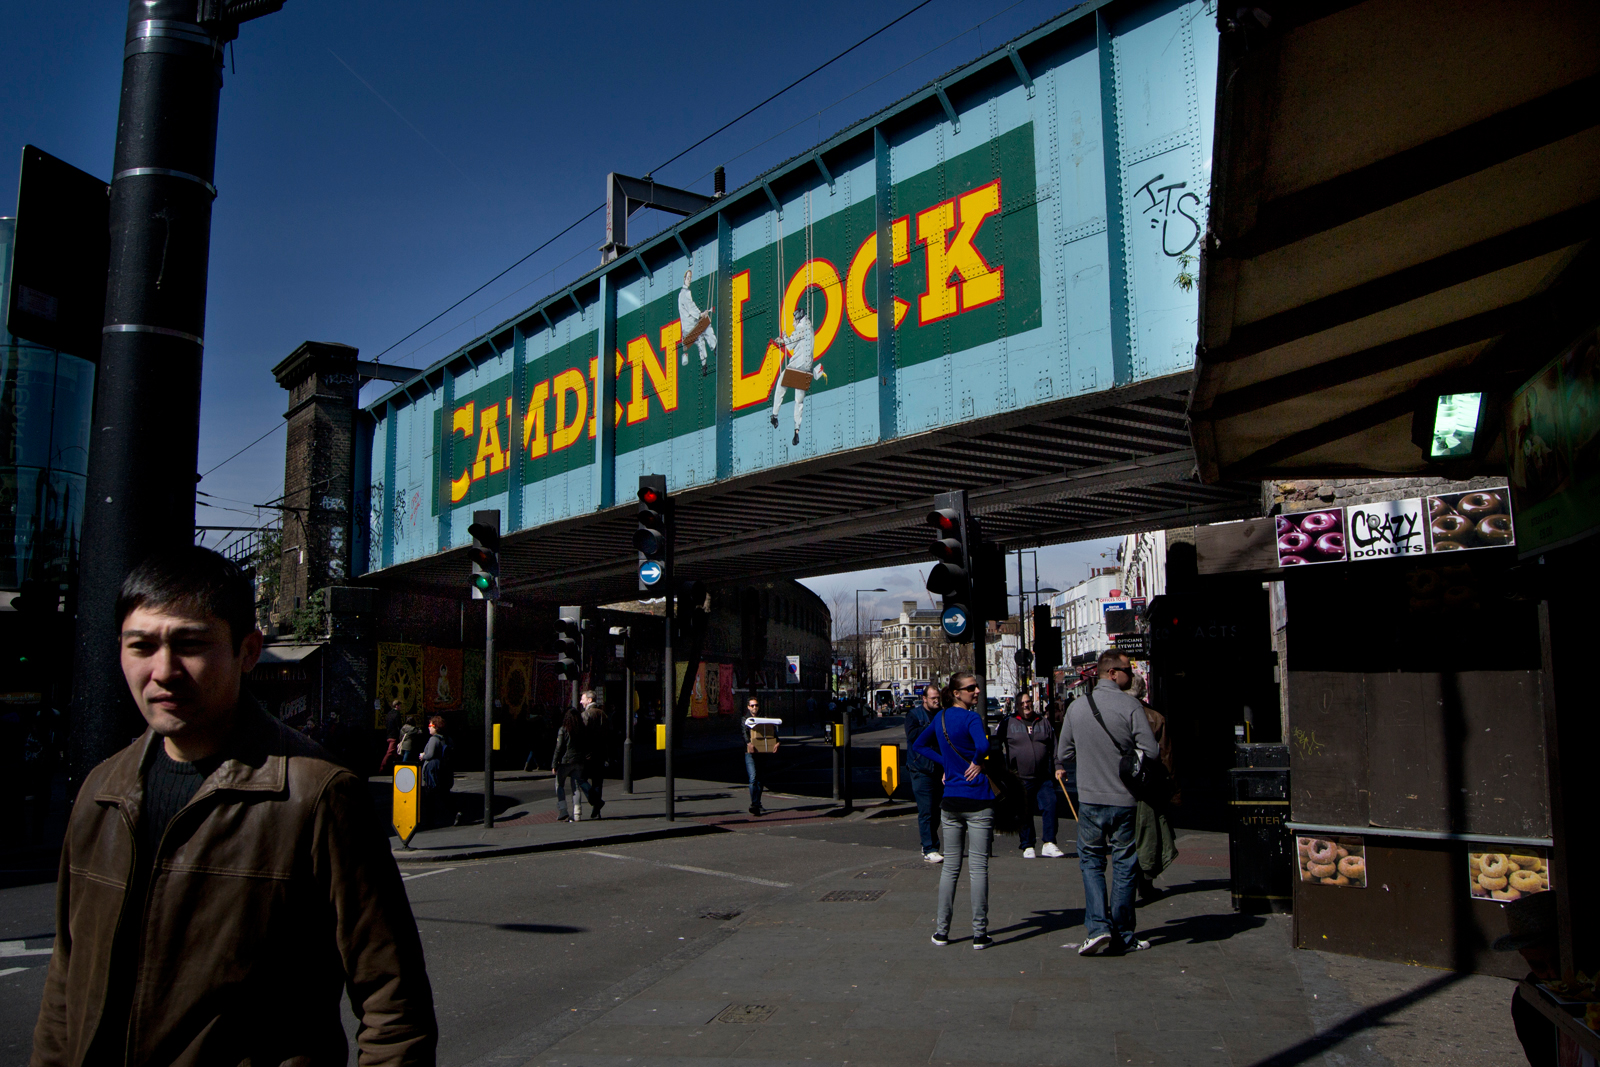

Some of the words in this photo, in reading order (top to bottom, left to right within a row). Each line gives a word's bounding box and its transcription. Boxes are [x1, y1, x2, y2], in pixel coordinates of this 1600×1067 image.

[731, 177, 1005, 411] LOCK
[1351, 510, 1421, 550] CRAZY
[1353, 544, 1424, 558] DONUTS
[1242, 816, 1280, 826] LITTER
